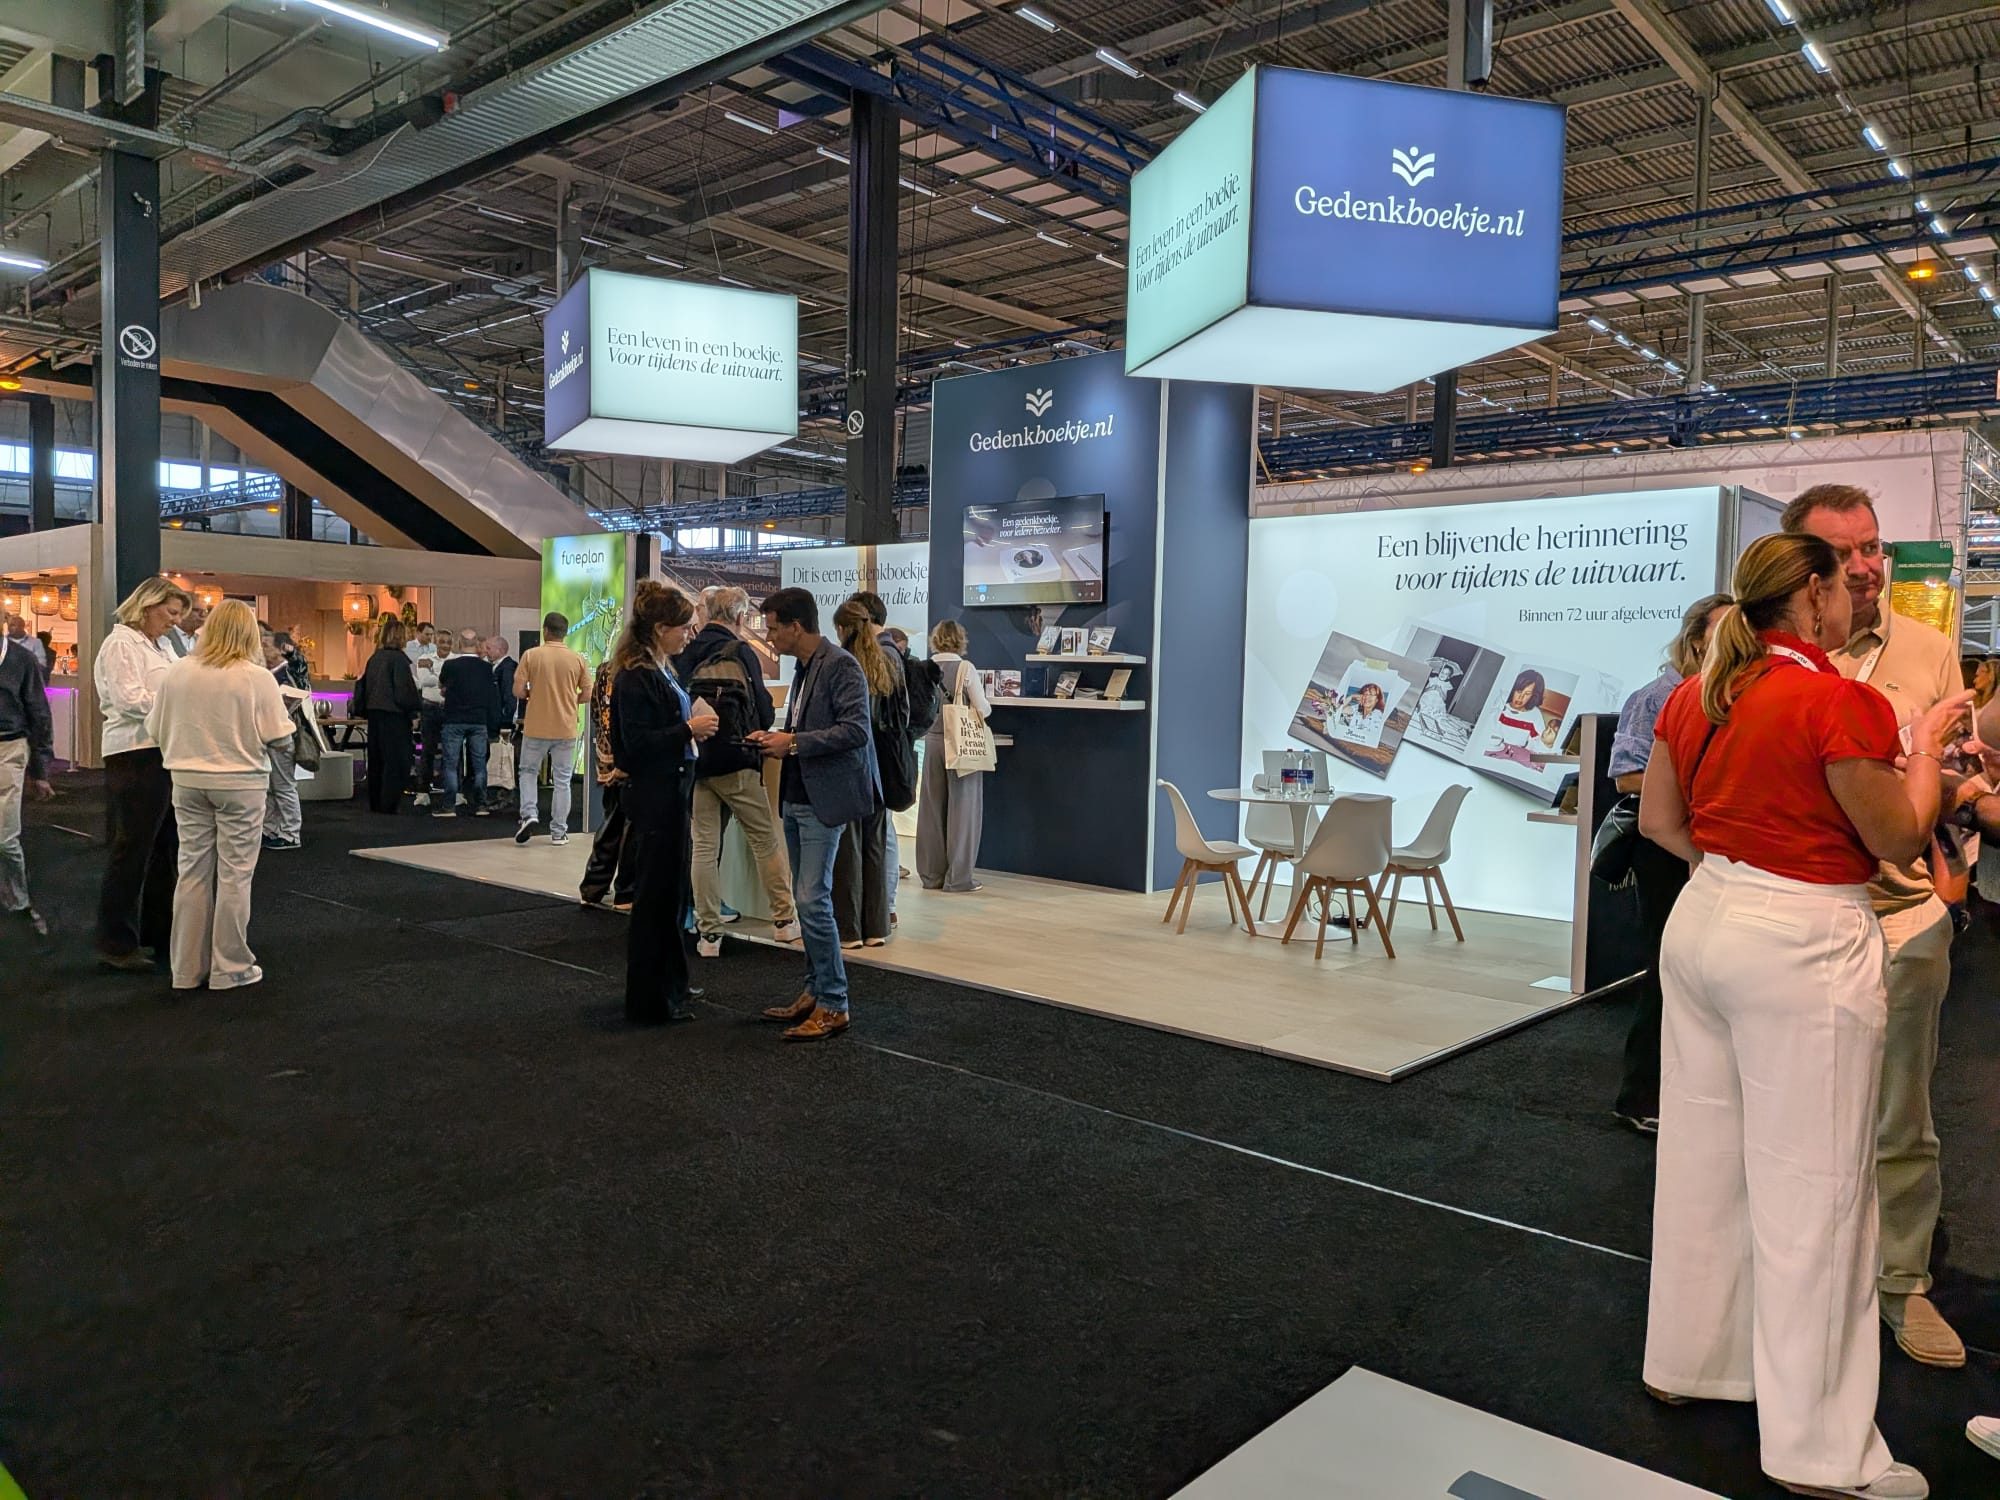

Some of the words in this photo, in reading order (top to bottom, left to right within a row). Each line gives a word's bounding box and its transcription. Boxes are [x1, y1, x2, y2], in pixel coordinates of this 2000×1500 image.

[1136, 245, 1151, 269] Een
[1152, 233, 1174, 257] leven
[1175, 216, 1184, 239] in
[1185, 203, 1203, 230] een
[1205, 173, 1240, 216] boekje.
[1295, 186, 1525, 237] Gedenkboekje.nl
[1136, 267, 1155, 294] Voor
[1154, 247, 1183, 284] tijdens
[1183, 232, 1196, 260] de
[1196, 204, 1239, 251] uitvaart.
[607, 327, 637, 347] Een
[641, 331, 681, 352] leven
[684, 336, 699, 354] in
[702, 342, 729, 357] een
[733, 341, 784, 366] boekje.
[609, 347, 645, 366] Voor
[648, 352, 698, 373] tijdens
[700, 357, 719, 375] de
[722, 361, 783, 382] uitvaart.
[969, 414, 1114, 452] Gedenkboekje.nl
[1002, 518, 1014, 527] Een
[1378, 534, 1419, 558] Een
[1425, 527, 1530, 561] blijvende
[1537, 519, 1688, 551] herinnering
[792, 567, 809, 584] Dit
[811, 567, 820, 583] is
[821, 569, 842, 583] een
[1395, 571, 1447, 591] voor
[1451, 563, 1528, 595] tijdens
[1535, 560, 1566, 587] de
[1571, 557, 1686, 586] uitvaart.
[815, 593, 840, 607] voor
[893, 587, 911, 605] die
[1519, 608, 1563, 622] Binnen
[1567, 608, 1583, 621] 72
[1585, 608, 1609, 621] uur
[958, 745, 968, 757] je
